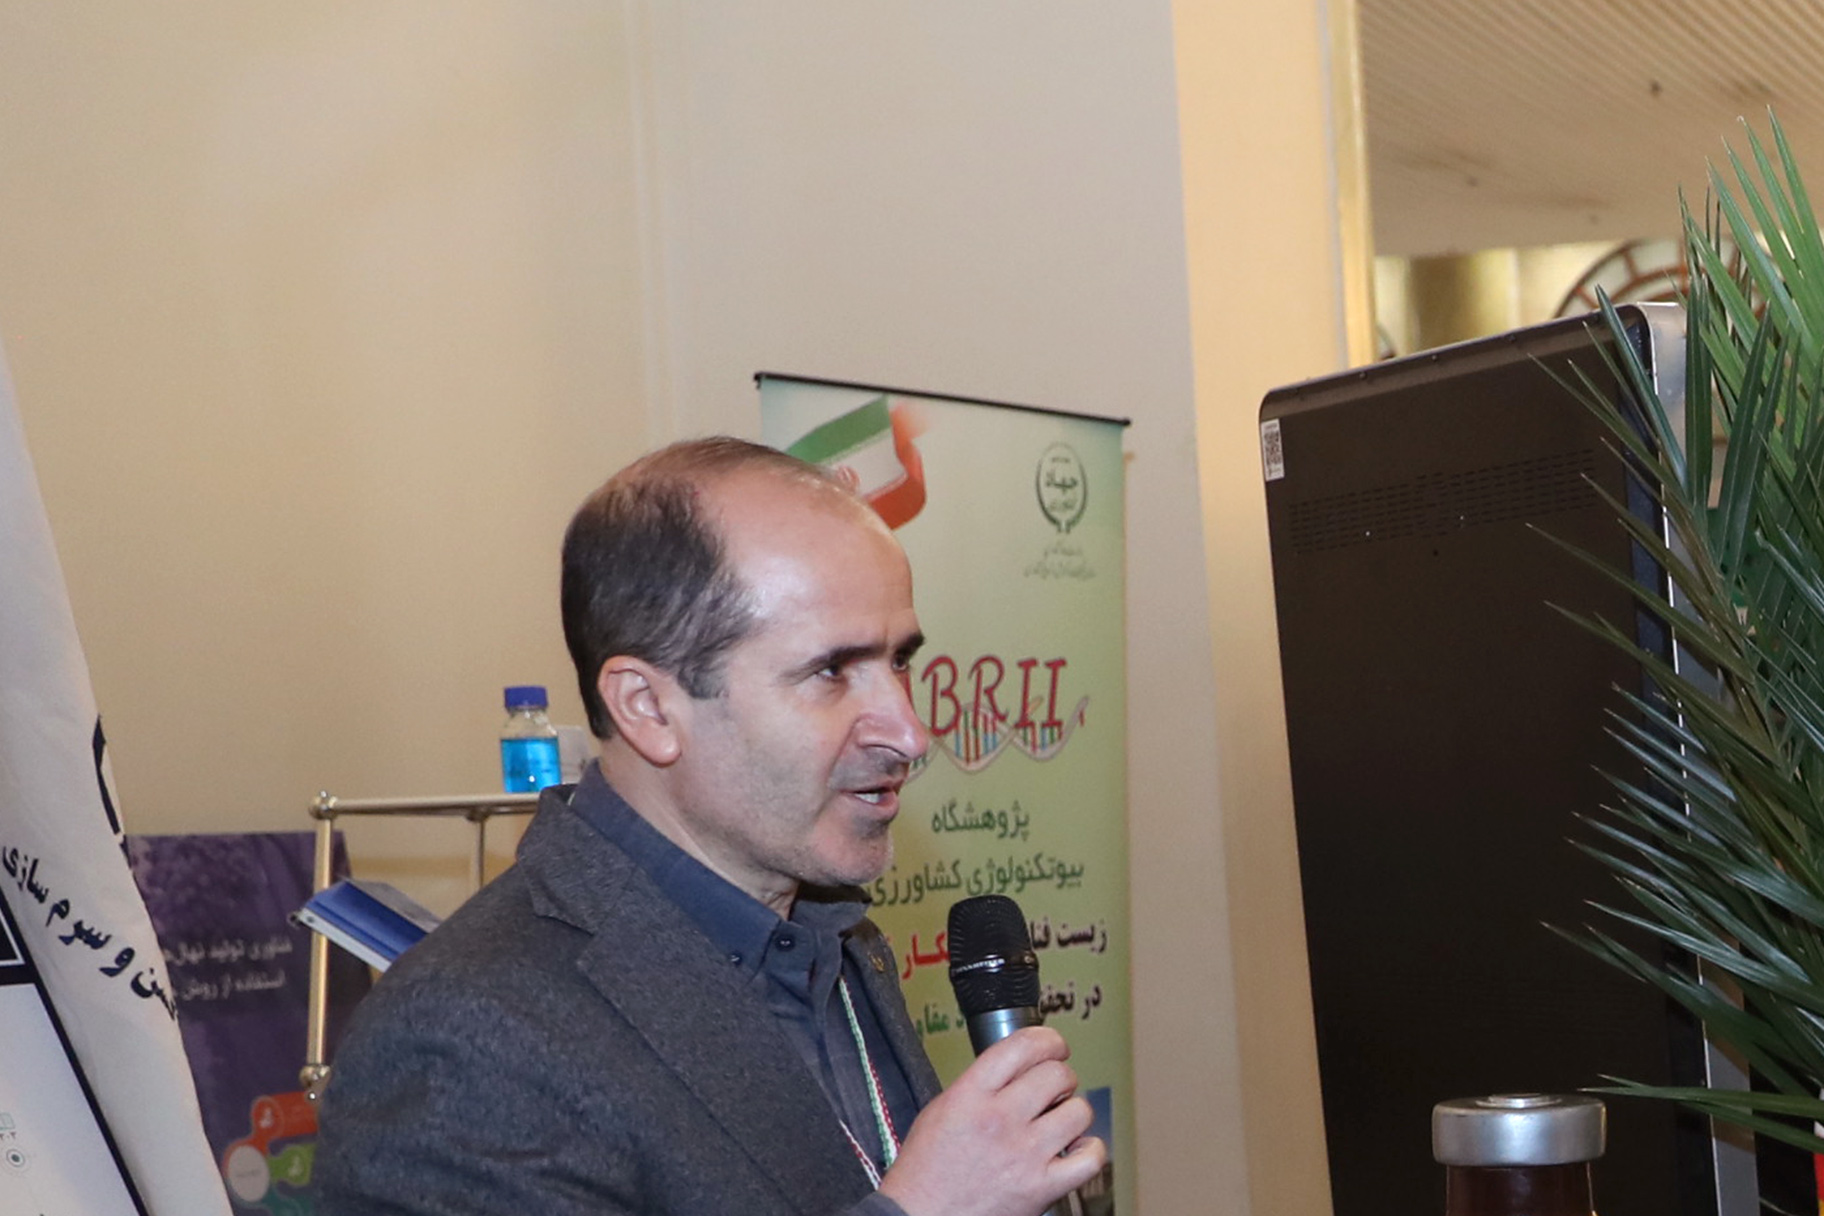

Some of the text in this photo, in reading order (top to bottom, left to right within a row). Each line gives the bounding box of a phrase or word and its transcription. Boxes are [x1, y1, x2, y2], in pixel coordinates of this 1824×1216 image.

[906, 655, 1067, 737] BRII
[931, 801, 1030, 841] پژوهشگاه
[872, 853, 1084, 907] بیوتکنولوژی کشاورزی
[1057, 920, 1107, 952] زیست
[1082, 985, 1103, 1019] در
